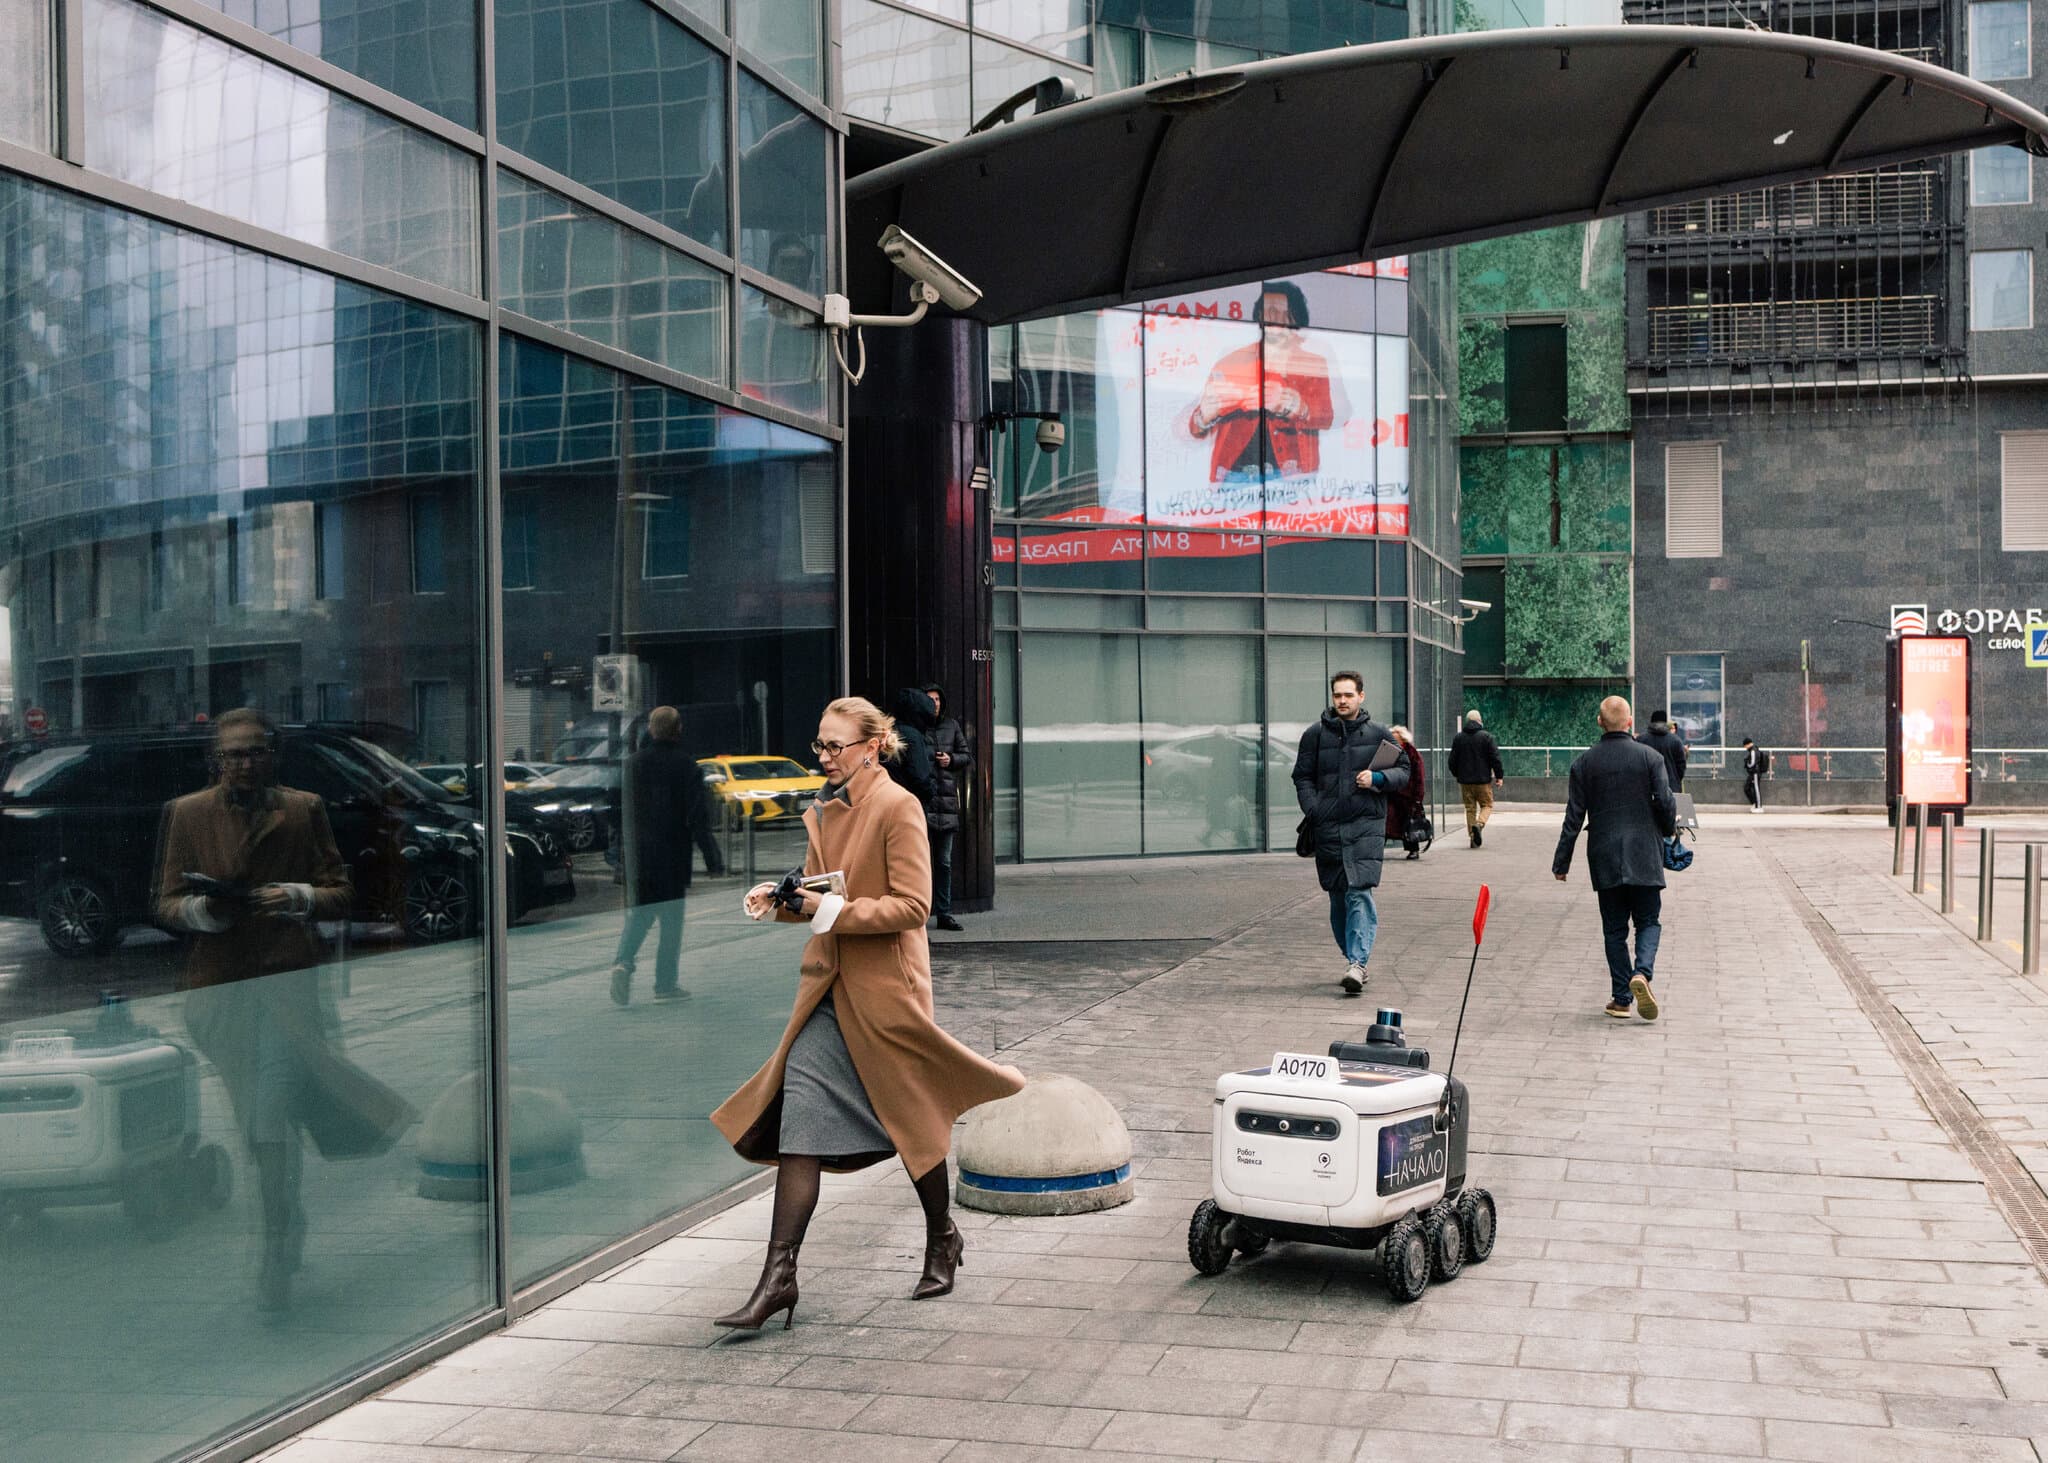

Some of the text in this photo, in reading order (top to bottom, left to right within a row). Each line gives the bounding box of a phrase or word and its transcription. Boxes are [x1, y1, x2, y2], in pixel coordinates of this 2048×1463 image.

[1277, 1058, 1326, 1078] A0170
[1237, 1147, 1255, 1156] Робот
[1384, 1141, 1444, 1187] НАЧАЛО
